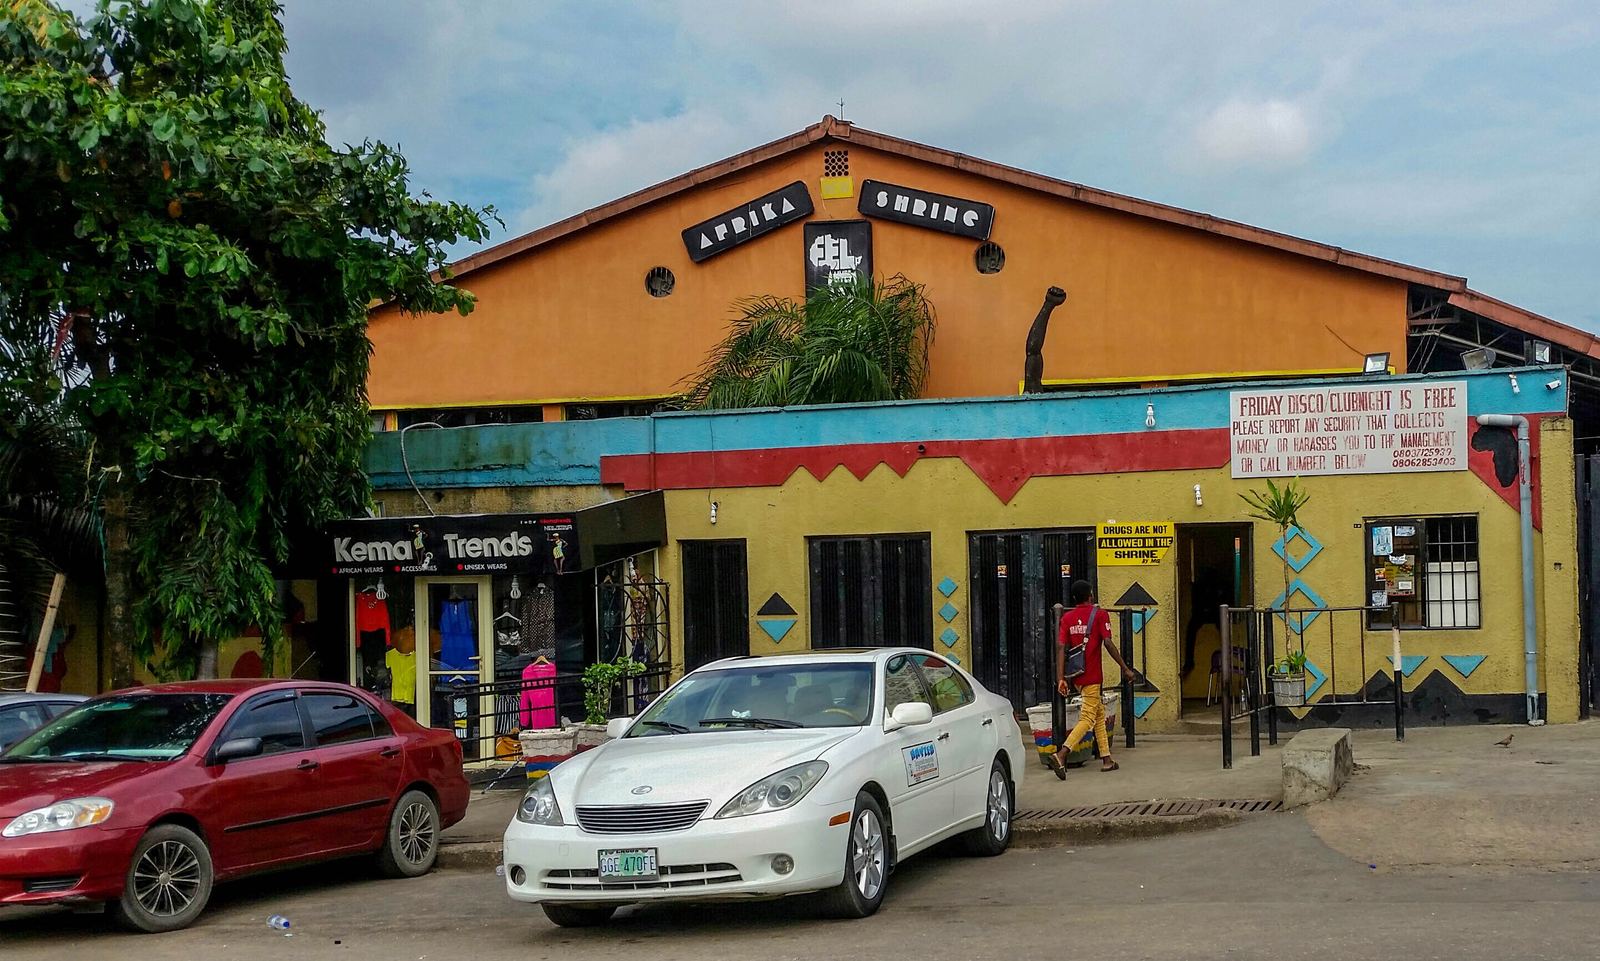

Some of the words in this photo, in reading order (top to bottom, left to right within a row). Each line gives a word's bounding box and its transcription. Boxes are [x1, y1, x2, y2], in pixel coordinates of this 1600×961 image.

[876, 190, 979, 227] SHRINE
[700, 197, 796, 250] AFRIKA
[1239, 395, 1283, 417] FRIDAY
[1400, 389, 1412, 409] IS
[1424, 387, 1456, 408] FREE
[1232, 420, 1264, 435] PLEASE
[1269, 418, 1300, 434] REPORT
[1304, 417, 1320, 433] ANY
[1323, 415, 1361, 432] SECURITY
[1366, 414, 1387, 430] THAT
[1394, 412, 1445, 429] COLLECTS
[1237, 438, 1269, 454] MONEY
[1277, 437, 1288, 453] OR
[1293, 436, 1337, 451] HARASSES
[1343, 434, 1359, 450] YOU
[1364, 434, 1376, 449] TO
[1381, 433, 1395, 449] THE
[1400, 430, 1456, 448] MANAGEMENT
[1241, 457, 1253, 473] OR
[1260, 456, 1281, 472] CALL
[1287, 455, 1326, 471] NUMBER
[1334, 453, 1367, 470] BELOW
[1103, 526, 1132, 534] DRUGS
[1135, 526, 1150, 534] ARE
[1153, 525, 1167, 534] NOT
[333, 537, 413, 562] Kema
[443, 531, 532, 559] Trends
[1101, 538, 1143, 547] ALLOWED
[1145, 538, 1154, 546] IN
[1155, 538, 1172, 547] THE
[1114, 550, 1158, 558] SHRINE
